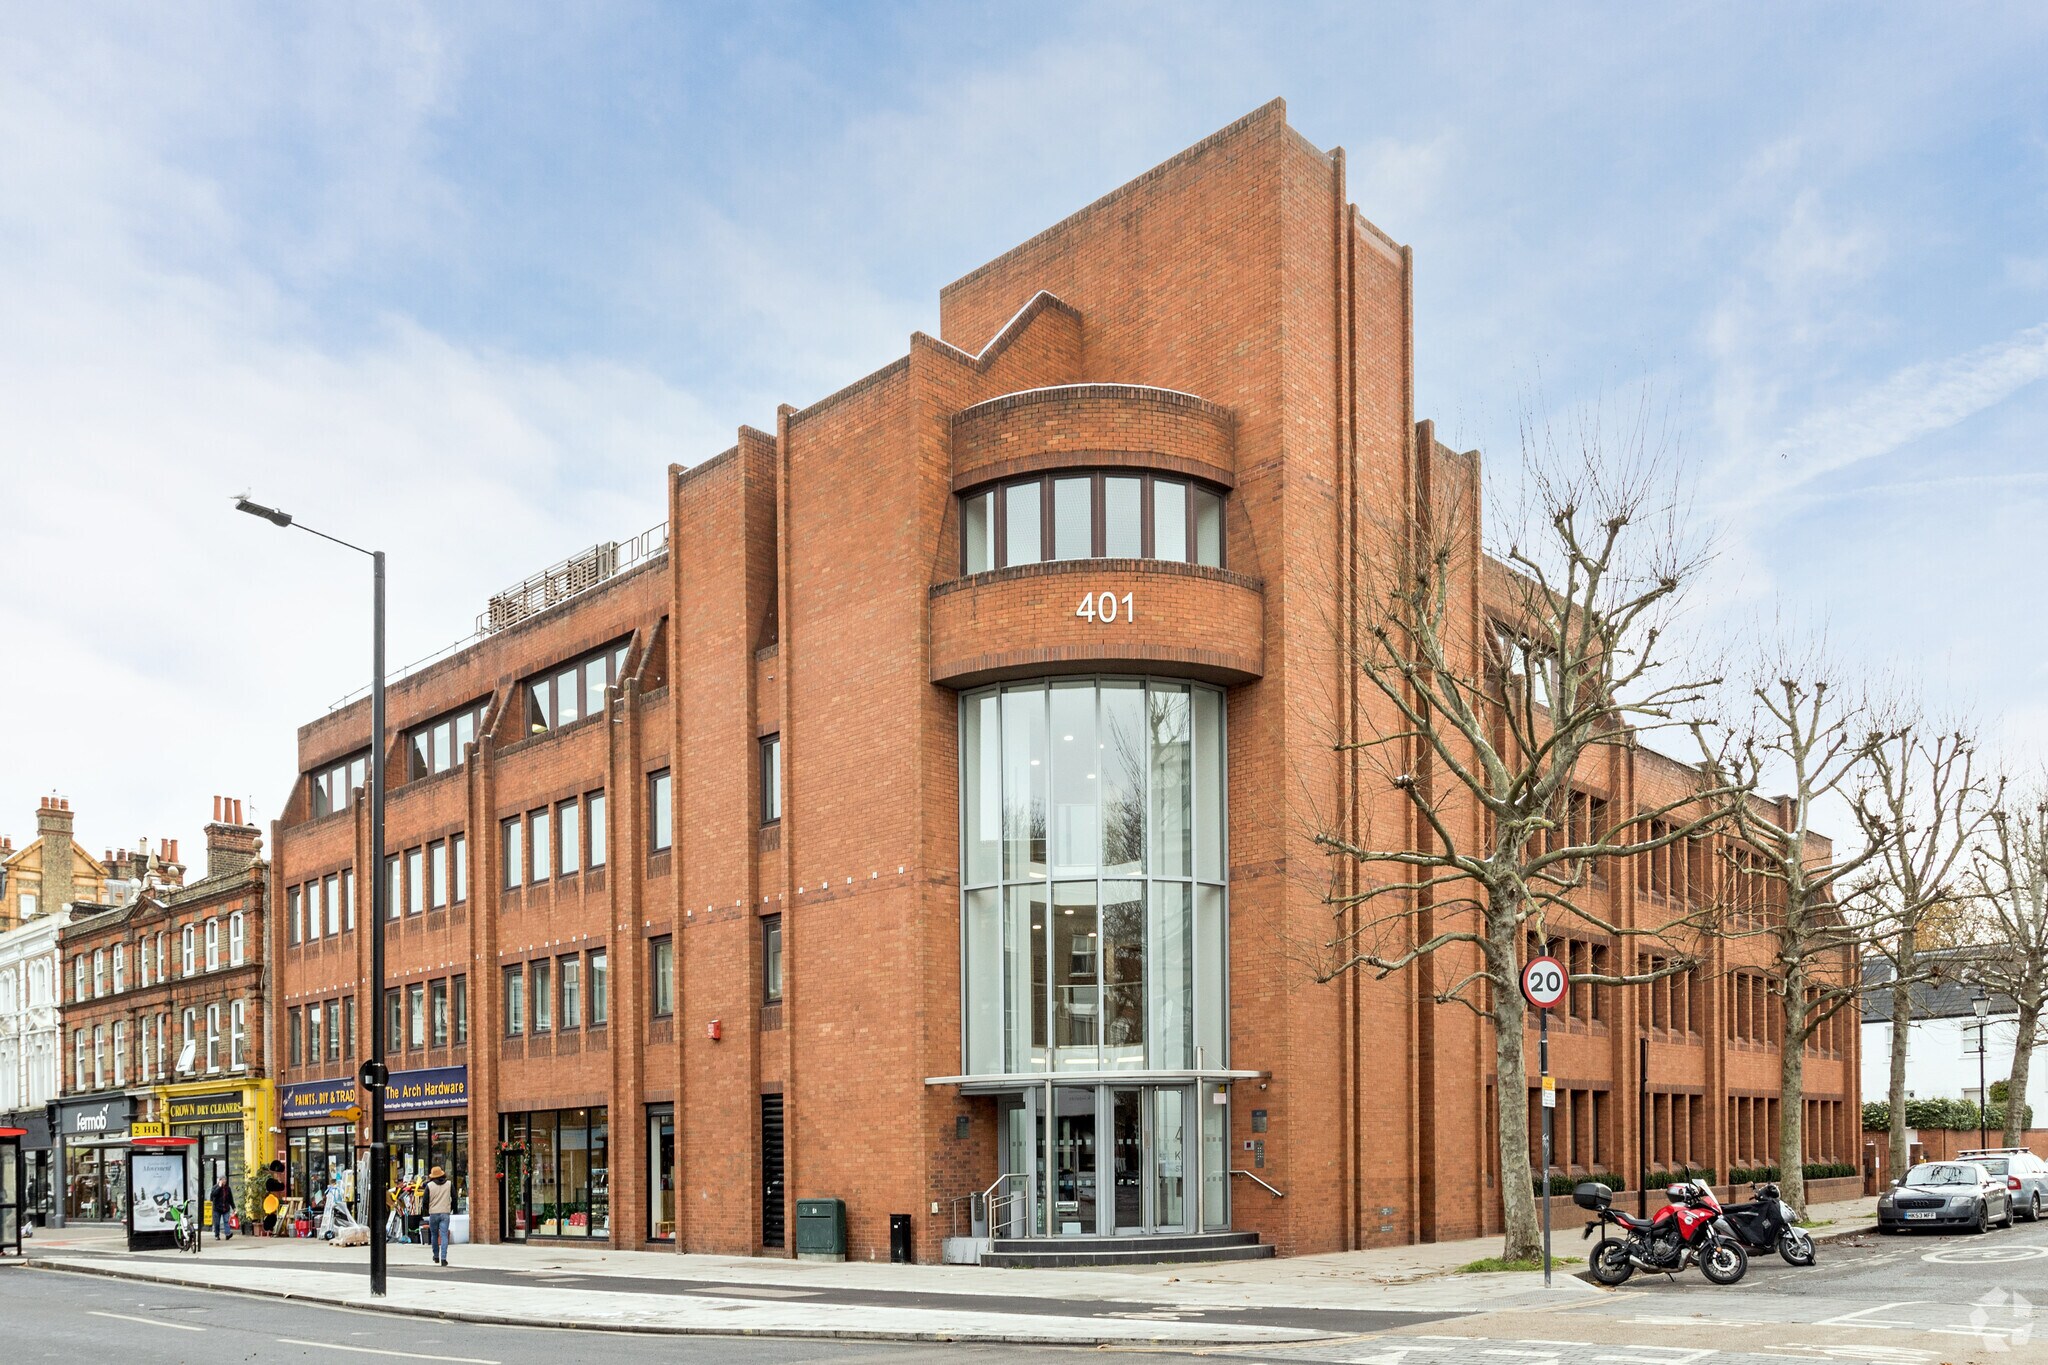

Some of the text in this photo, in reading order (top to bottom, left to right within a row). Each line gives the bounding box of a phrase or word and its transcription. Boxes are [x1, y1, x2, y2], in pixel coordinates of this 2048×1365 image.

[1076, 591, 1133, 623] 401
[1530, 971, 1561, 992] 20
[295, 1092, 318, 1107] PAINTS,
[319, 1091, 328, 1105] DIY
[330, 1091, 335, 1104] &
[336, 1089, 355, 1103] TRAD
[385, 1082, 464, 1099] The Arch Hardware
[170, 1102, 242, 1117] CROWN DRY CLEANERS
[134, 1126, 159, 1134] 2 HR
